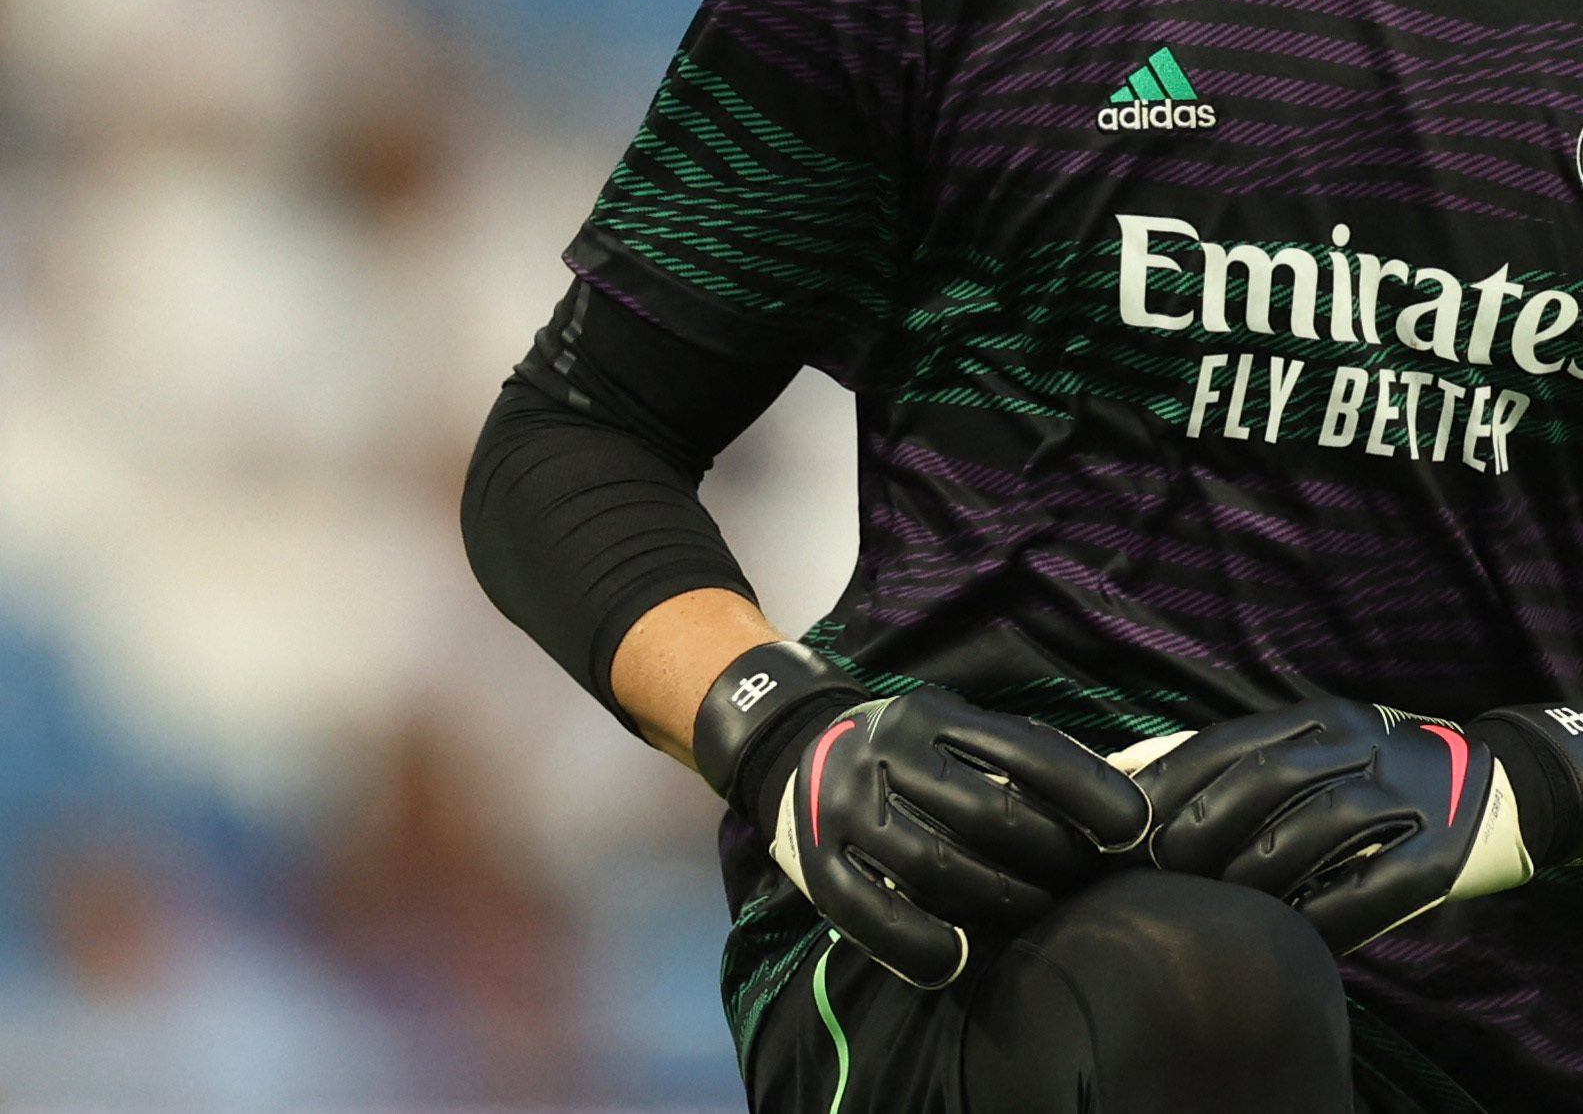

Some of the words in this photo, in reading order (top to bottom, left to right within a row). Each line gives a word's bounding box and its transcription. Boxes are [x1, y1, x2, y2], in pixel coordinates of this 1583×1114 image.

[1097, 98, 1217, 131] adidas
[1186, 353, 1305, 444] FLY
[1318, 366, 1531, 476] BETTER
